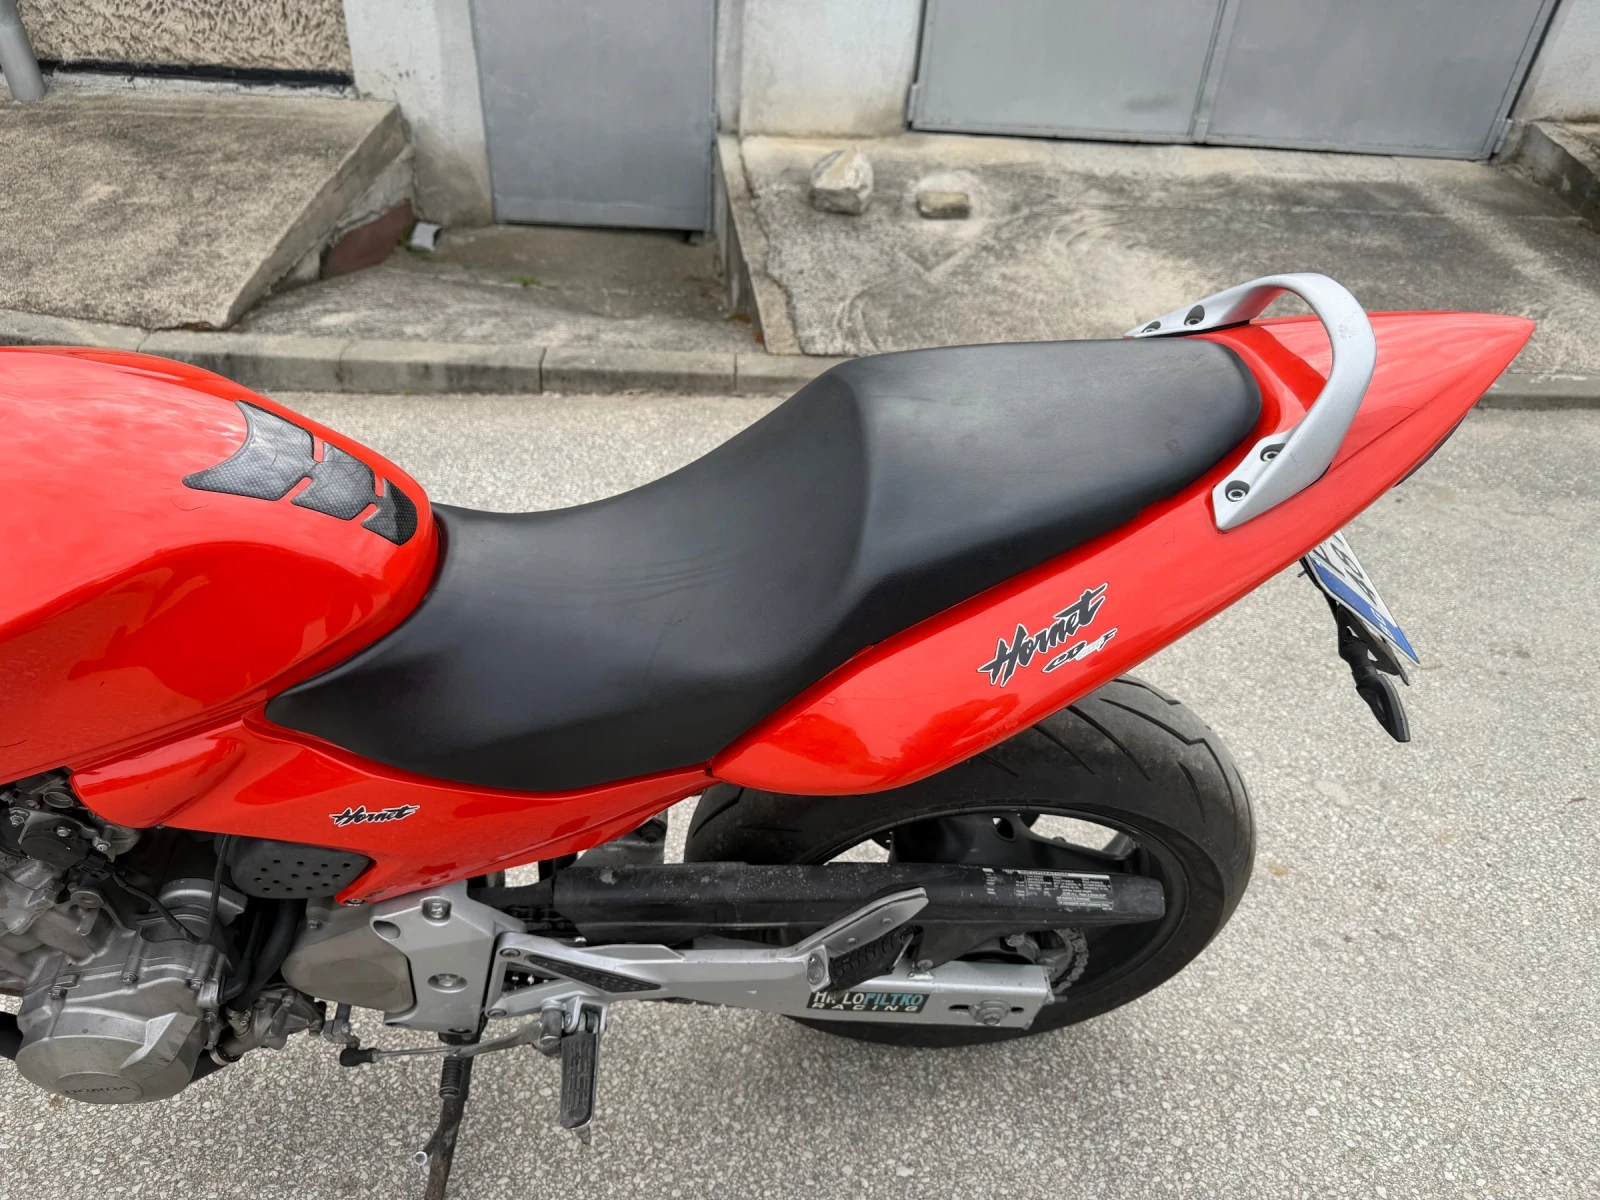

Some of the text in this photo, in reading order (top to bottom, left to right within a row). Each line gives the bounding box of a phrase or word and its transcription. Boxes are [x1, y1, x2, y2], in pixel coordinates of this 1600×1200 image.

[977, 582, 1108, 686] Hornet
[1370, 607, 1397, 642] BG
[330, 804, 421, 827] Hornet
[811, 1003, 918, 1012] RACING
